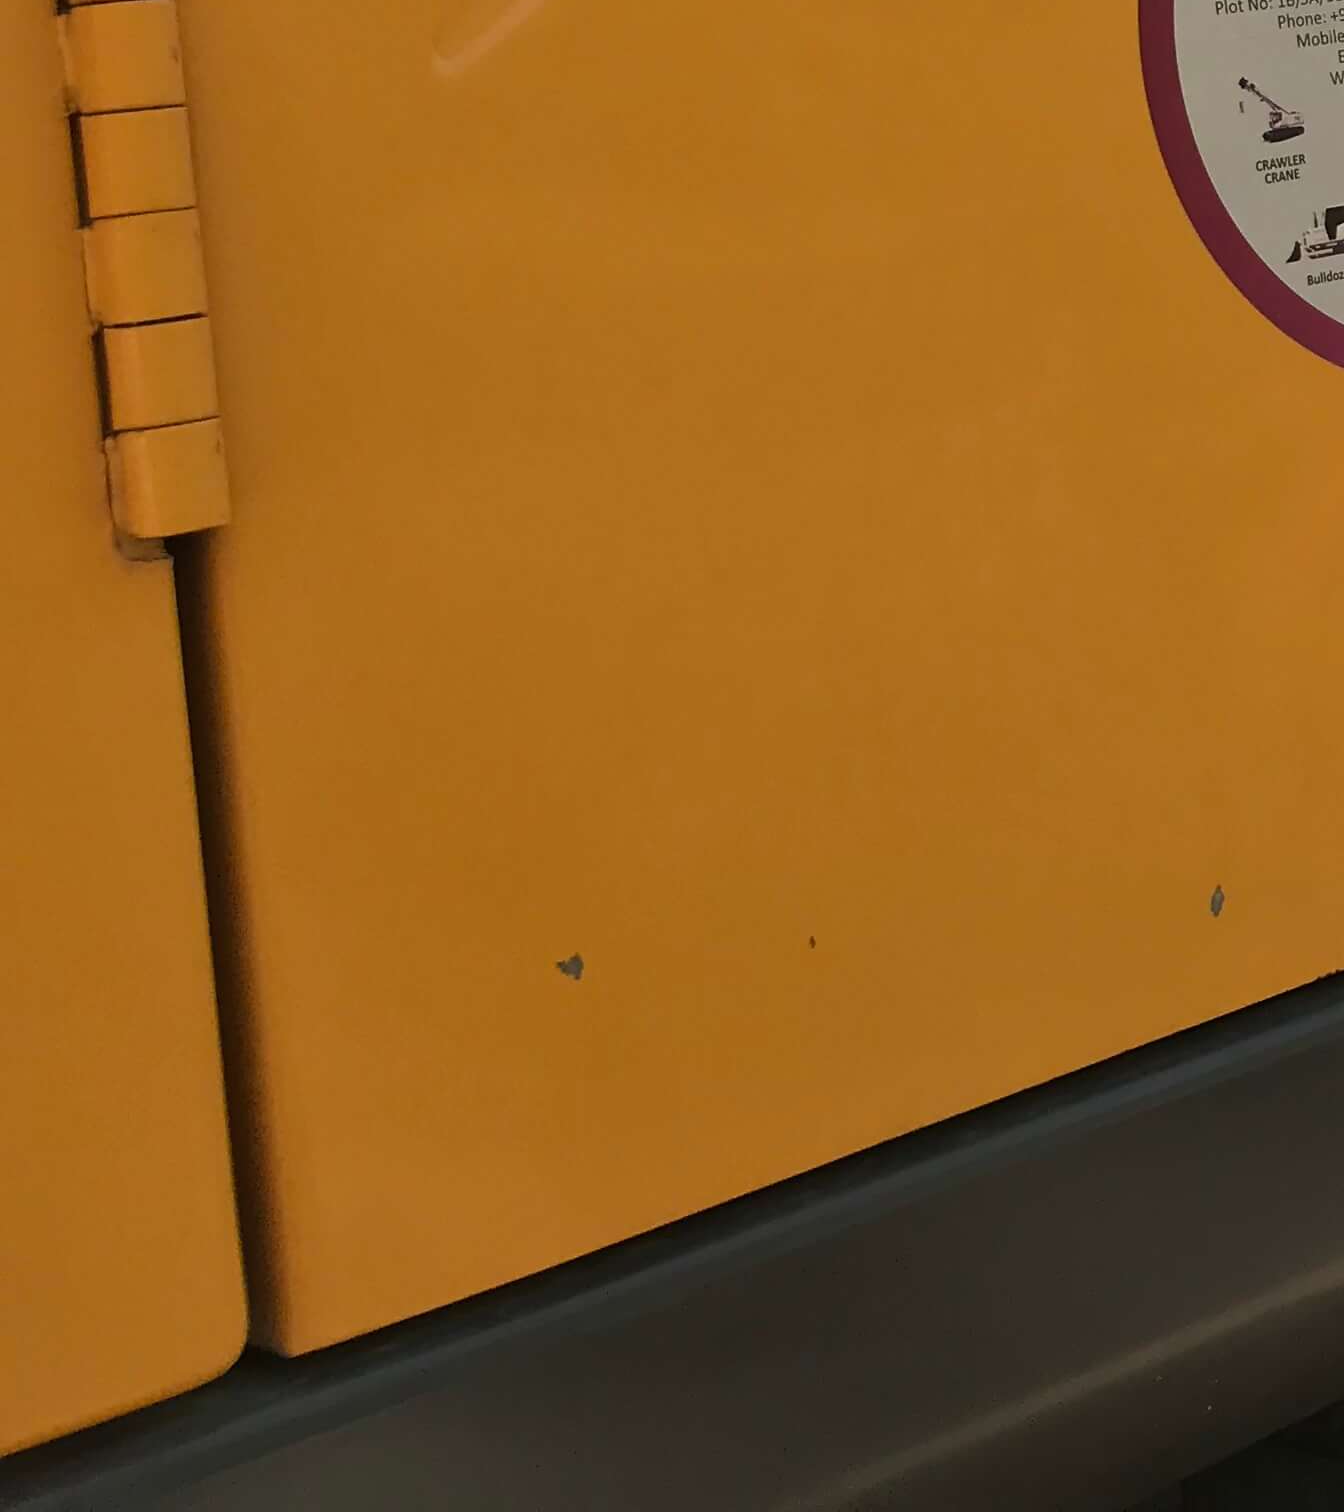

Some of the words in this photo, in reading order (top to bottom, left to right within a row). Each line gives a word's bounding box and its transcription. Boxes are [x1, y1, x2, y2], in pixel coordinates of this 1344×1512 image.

[1215, 0, 1244, 15] Plot
[1277, 12, 1327, 29] Phone:
[1255, 153, 1307, 173] CRAWLER
[1264, 167, 1301, 185] CRANE
